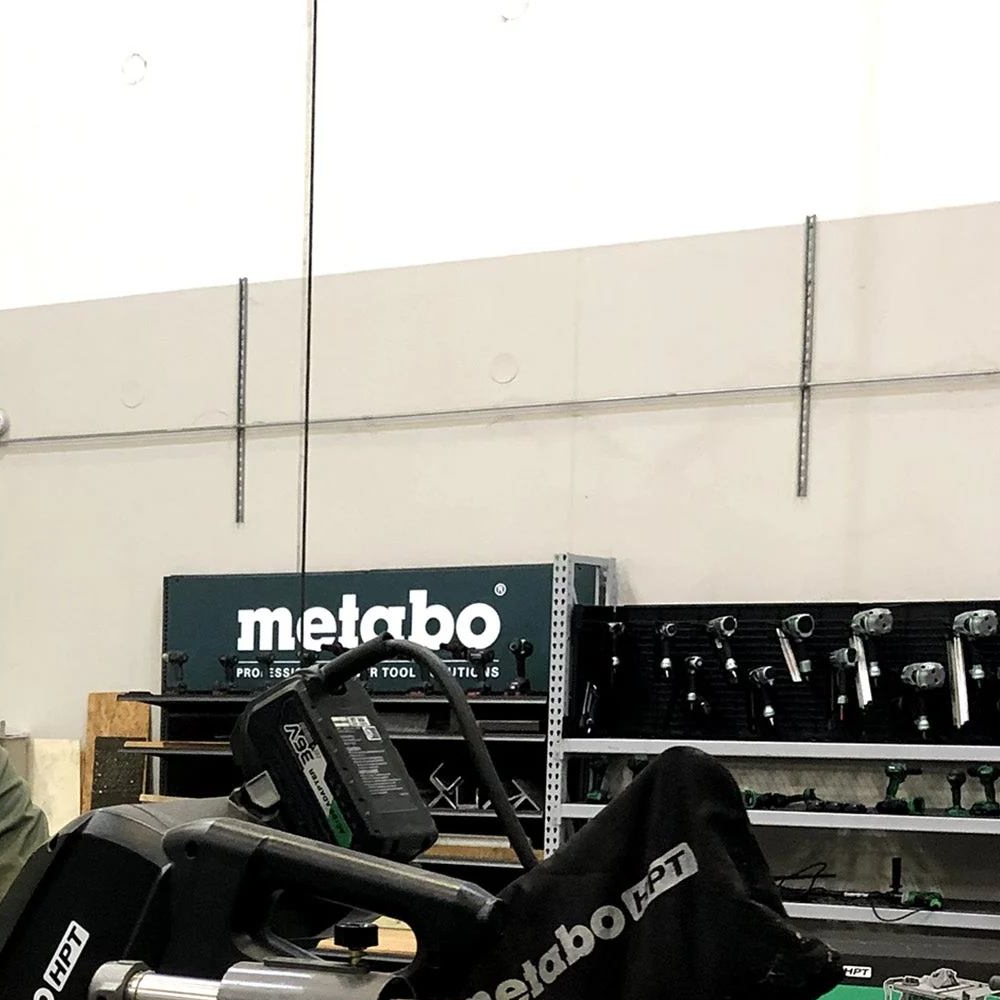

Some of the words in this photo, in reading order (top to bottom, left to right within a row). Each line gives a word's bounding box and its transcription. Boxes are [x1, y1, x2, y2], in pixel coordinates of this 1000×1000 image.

[382, 666, 416, 678] TOOL
[284, 723, 316, 767] 36V
[308, 768, 332, 808] ADAPTER
